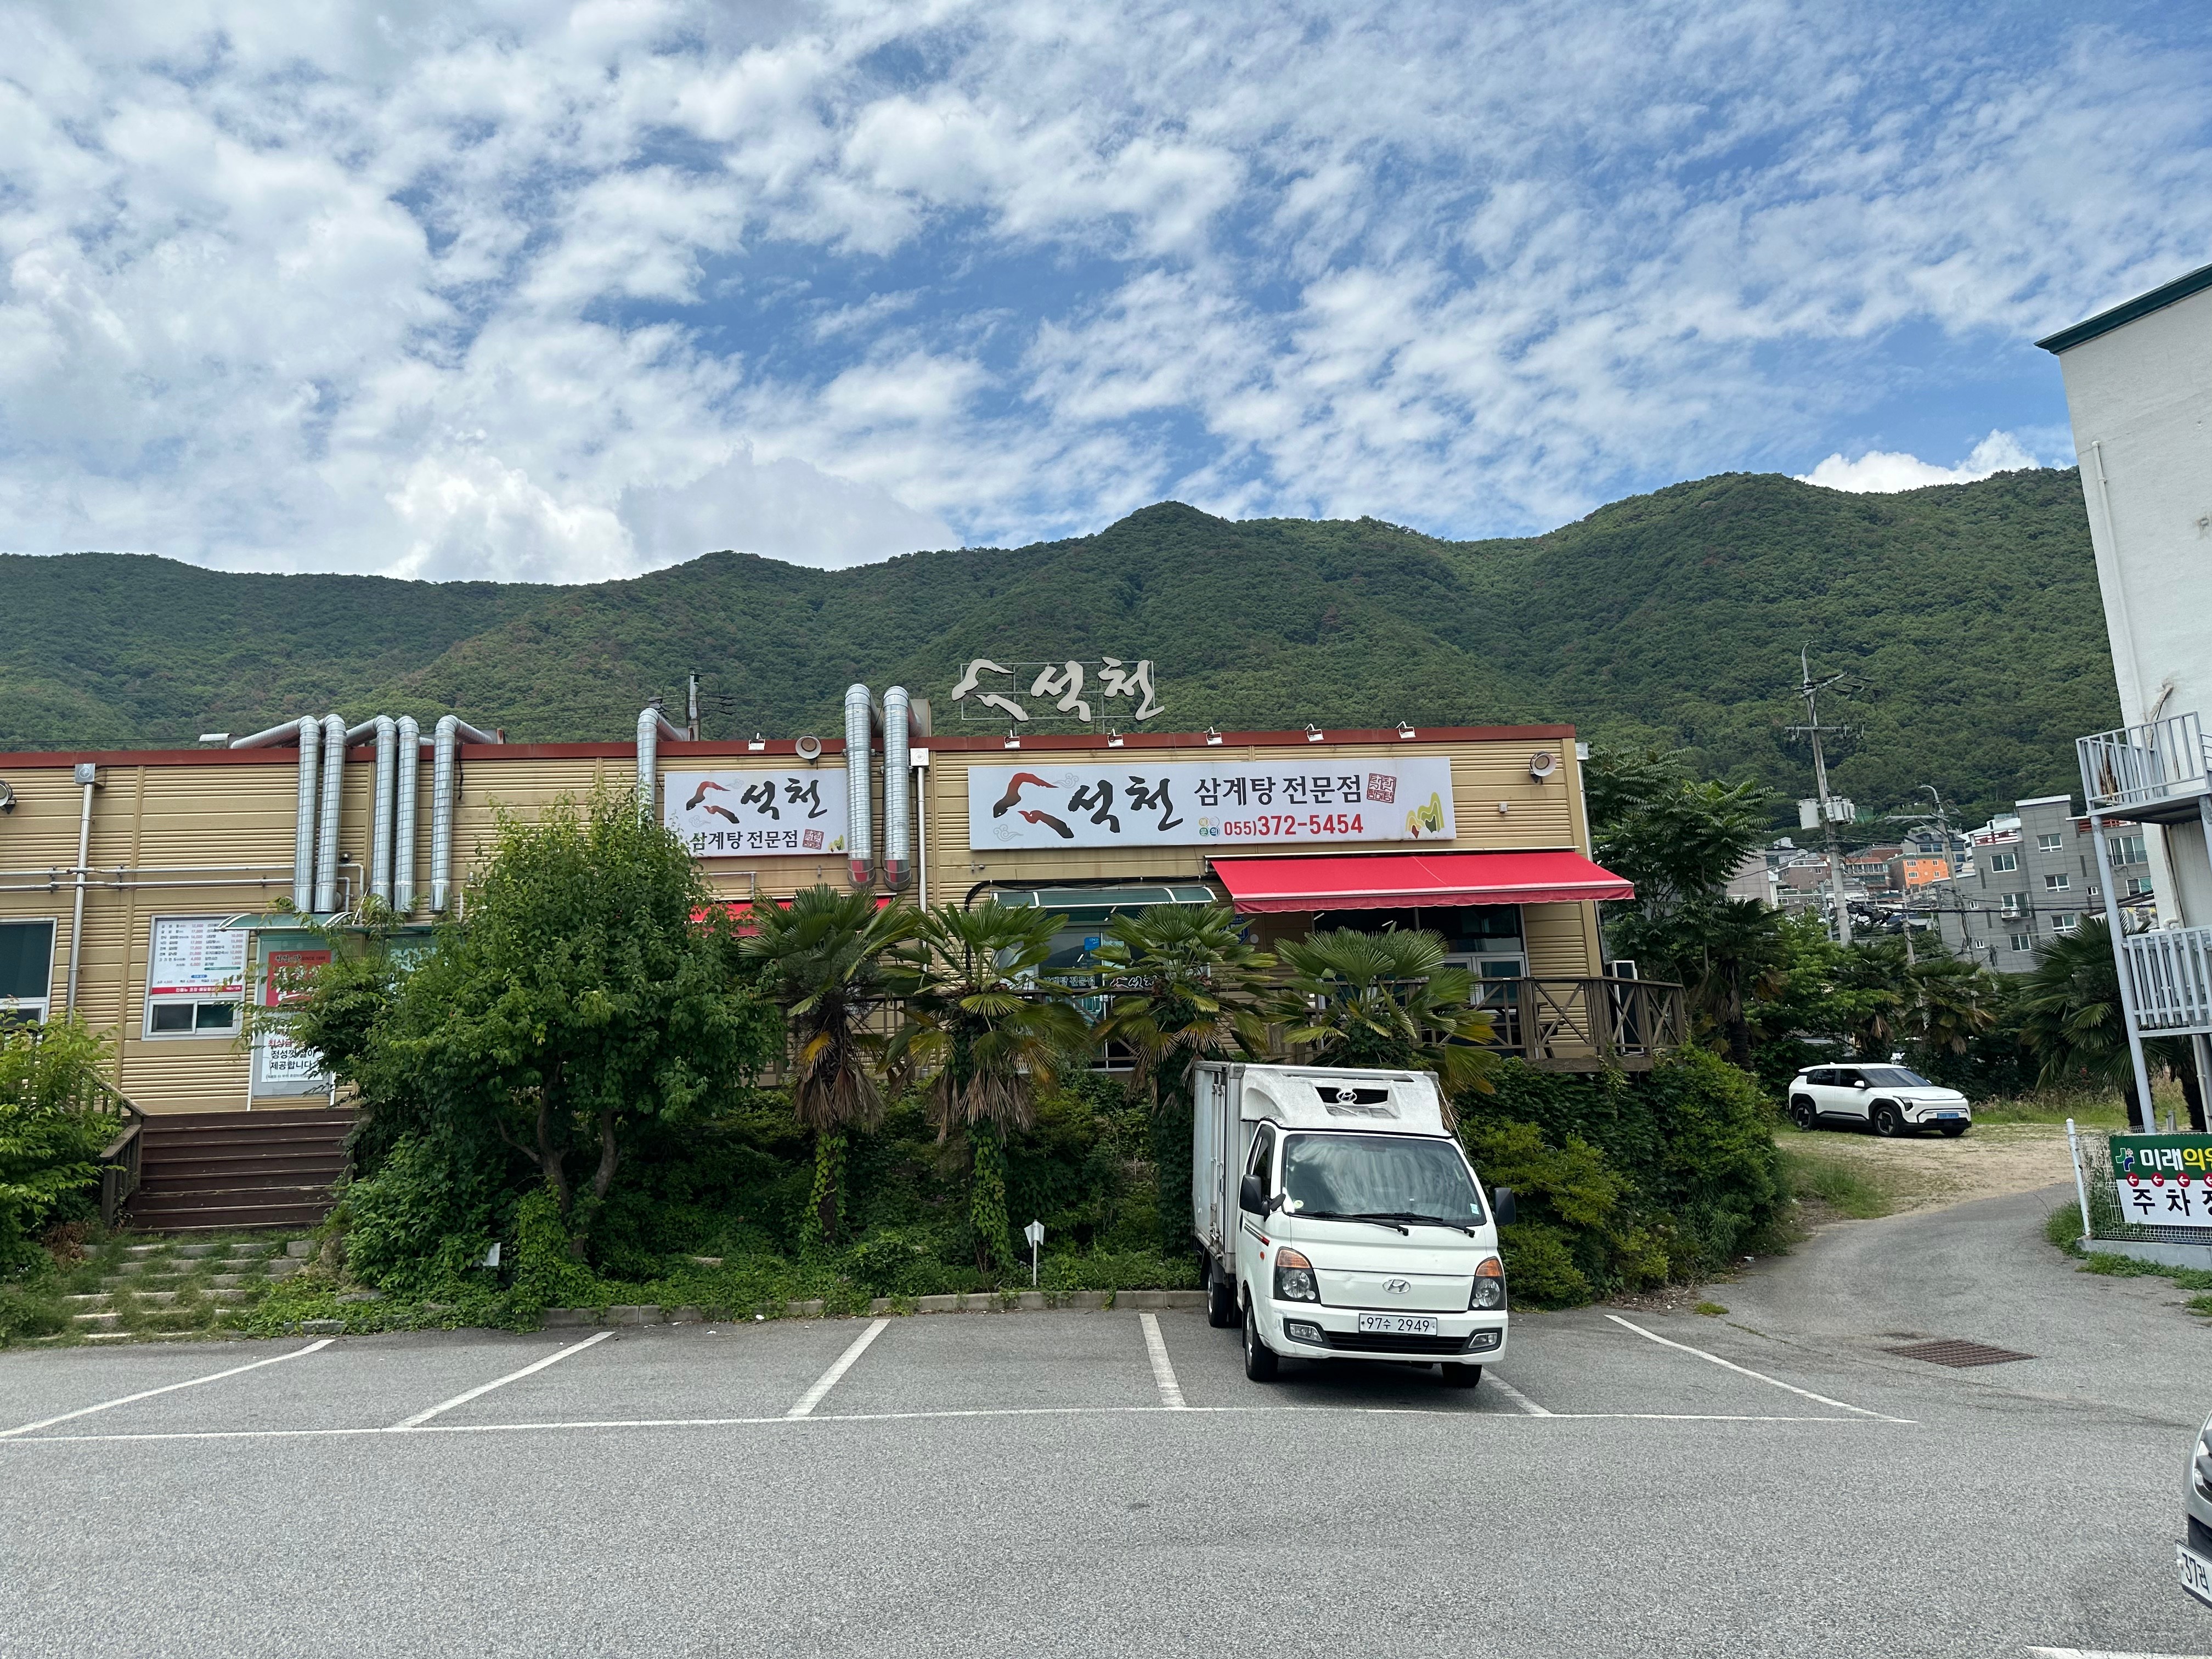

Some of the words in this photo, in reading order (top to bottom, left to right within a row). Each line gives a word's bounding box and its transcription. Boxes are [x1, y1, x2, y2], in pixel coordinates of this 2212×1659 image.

[1194, 776, 1276, 806] 삼계탕
[1282, 775, 1362, 804] 전문점
[1224, 814, 1364, 836] 055)372-5454
[690, 832, 743, 850] 삼계탕
[747, 830, 798, 849] 전문점
[1367, 1317, 1391, 1330] 97수
[1398, 1318, 1430, 1332] 2949
